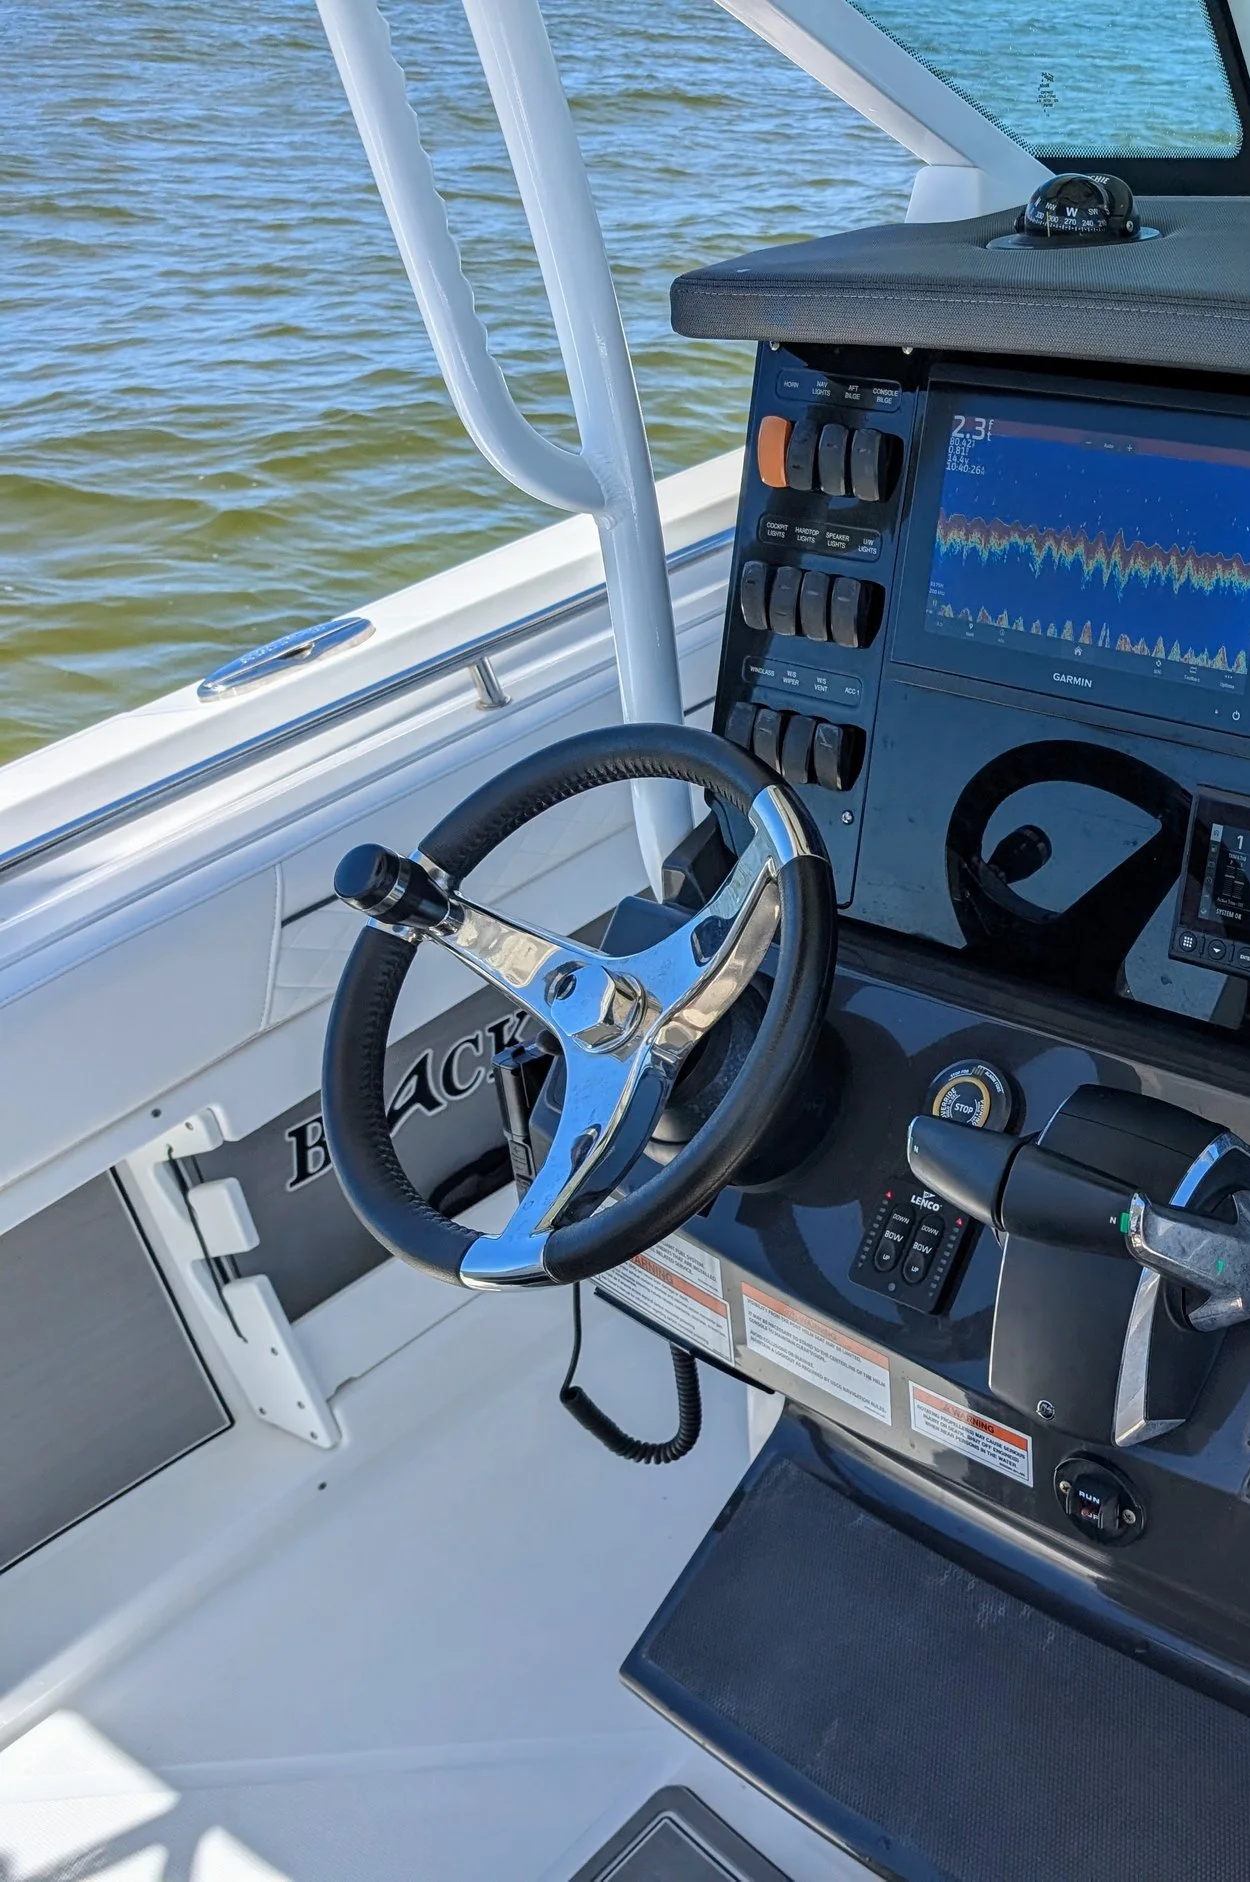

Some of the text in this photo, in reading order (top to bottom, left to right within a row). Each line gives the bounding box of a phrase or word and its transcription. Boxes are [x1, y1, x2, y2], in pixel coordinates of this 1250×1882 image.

[1066, 207, 1078, 217] W
[812, 388, 830, 396] LIGHTS
[873, 388, 898, 397] CONSOLE
[876, 396, 892, 404] BILGE
[952, 415, 986, 440] 2.3
[949, 446, 965, 455] 0.81
[946, 462, 980, 474] 10:40:26
[766, 522, 788, 531] COCKPIT
[795, 527, 819, 535] HARDTOP
[767, 530, 785, 538] LIGHTS
[826, 532, 849, 541] SPEAKER
[858, 546, 877, 554] LIGHTS
[750, 666, 775, 677] WINDLASS
[783, 677, 799, 686] WIPER
[1053, 673, 1092, 688] GARMIN
[814, 684, 828, 692] VENT
[845, 687, 856, 695] ACC
[1237, 835, 1243, 849] 1
[1216, 909, 1234, 918] SYSTEM
[954, 1104, 974, 1114] STOP
[910, 1195, 940, 1211] LENCO
[892, 1213, 909, 1224] DOWN
[1109, 1216, 1117, 1225] N
[921, 1225, 939, 1236] DOWN
[884, 1230, 904, 1242] BOW
[913, 1242, 932, 1254] BOW
[951, 1406, 994, 1434] WARNING
[940, 1428, 954, 1439] NEAR
[955, 1435, 979, 1451] PERSONS
[987, 1450, 996, 1459] THE
[966, 1434, 980, 1445] SHUT
[981, 1441, 991, 1450] OFF
[975, 1431, 984, 1440] MAY
[985, 1436, 1001, 1448] CAUSE
[1003, 1445, 1024, 1459] SERIOUS
[1079, 1490, 1100, 1504] RUN
